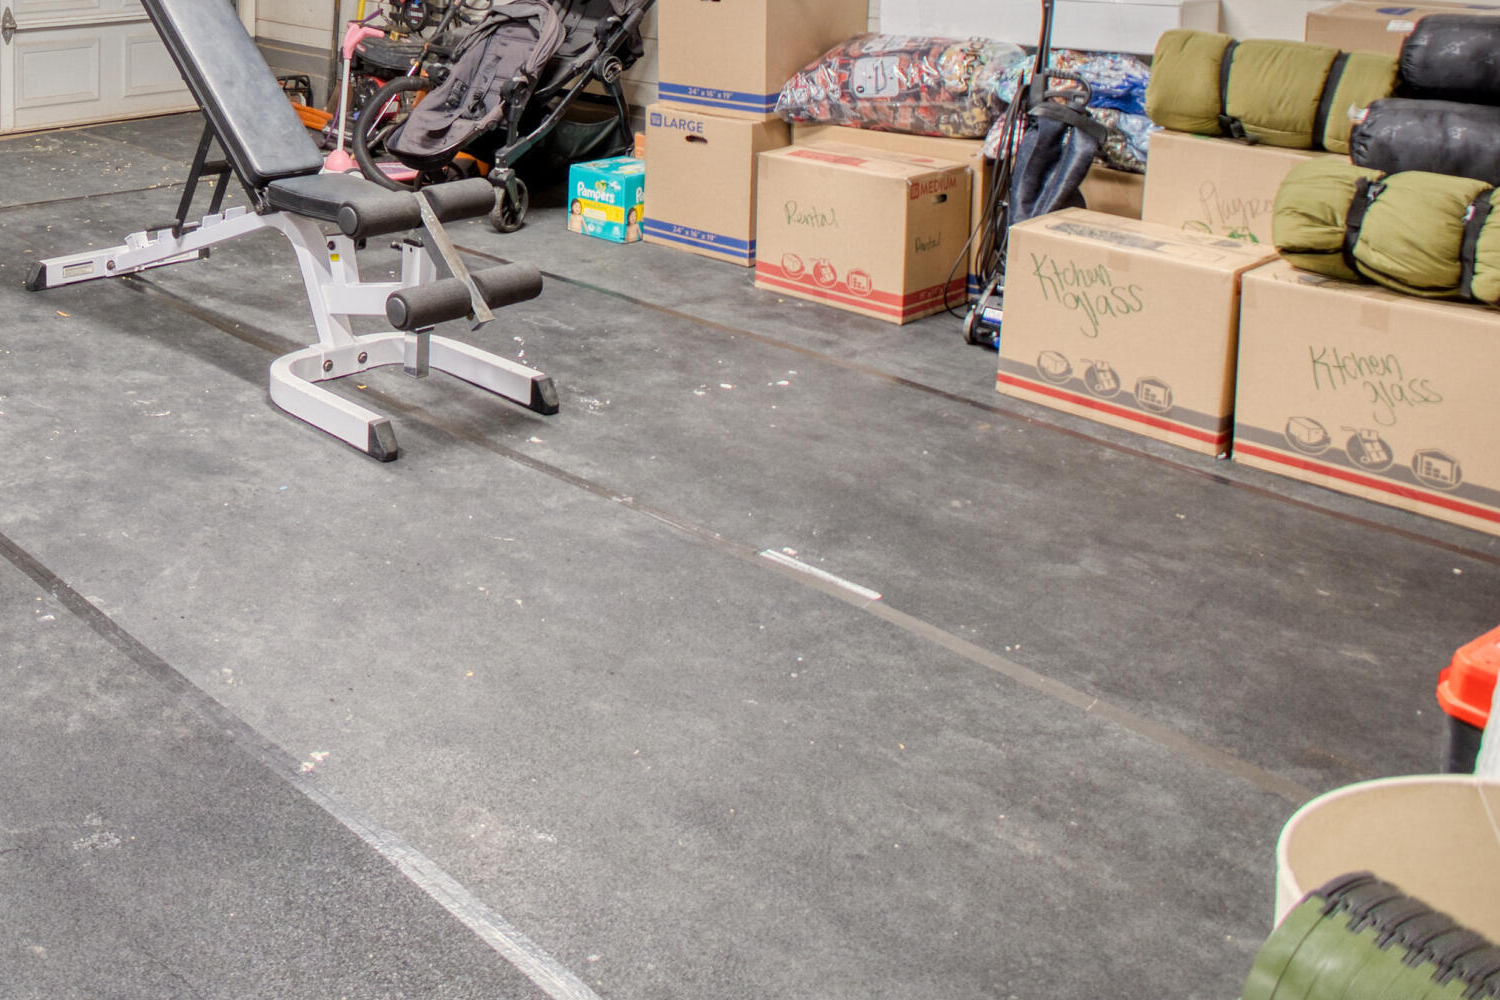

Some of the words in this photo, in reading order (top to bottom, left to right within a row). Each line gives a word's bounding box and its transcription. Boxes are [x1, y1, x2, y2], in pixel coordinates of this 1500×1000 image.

[663, 115, 704, 133] LARGE
[577, 181, 615, 204] Pampers
[920, 177, 957, 195] MEDIUM
[785, 200, 839, 228] Rental
[1063, 284, 1144, 339] glass
[1363, 378, 1444, 426] glass
